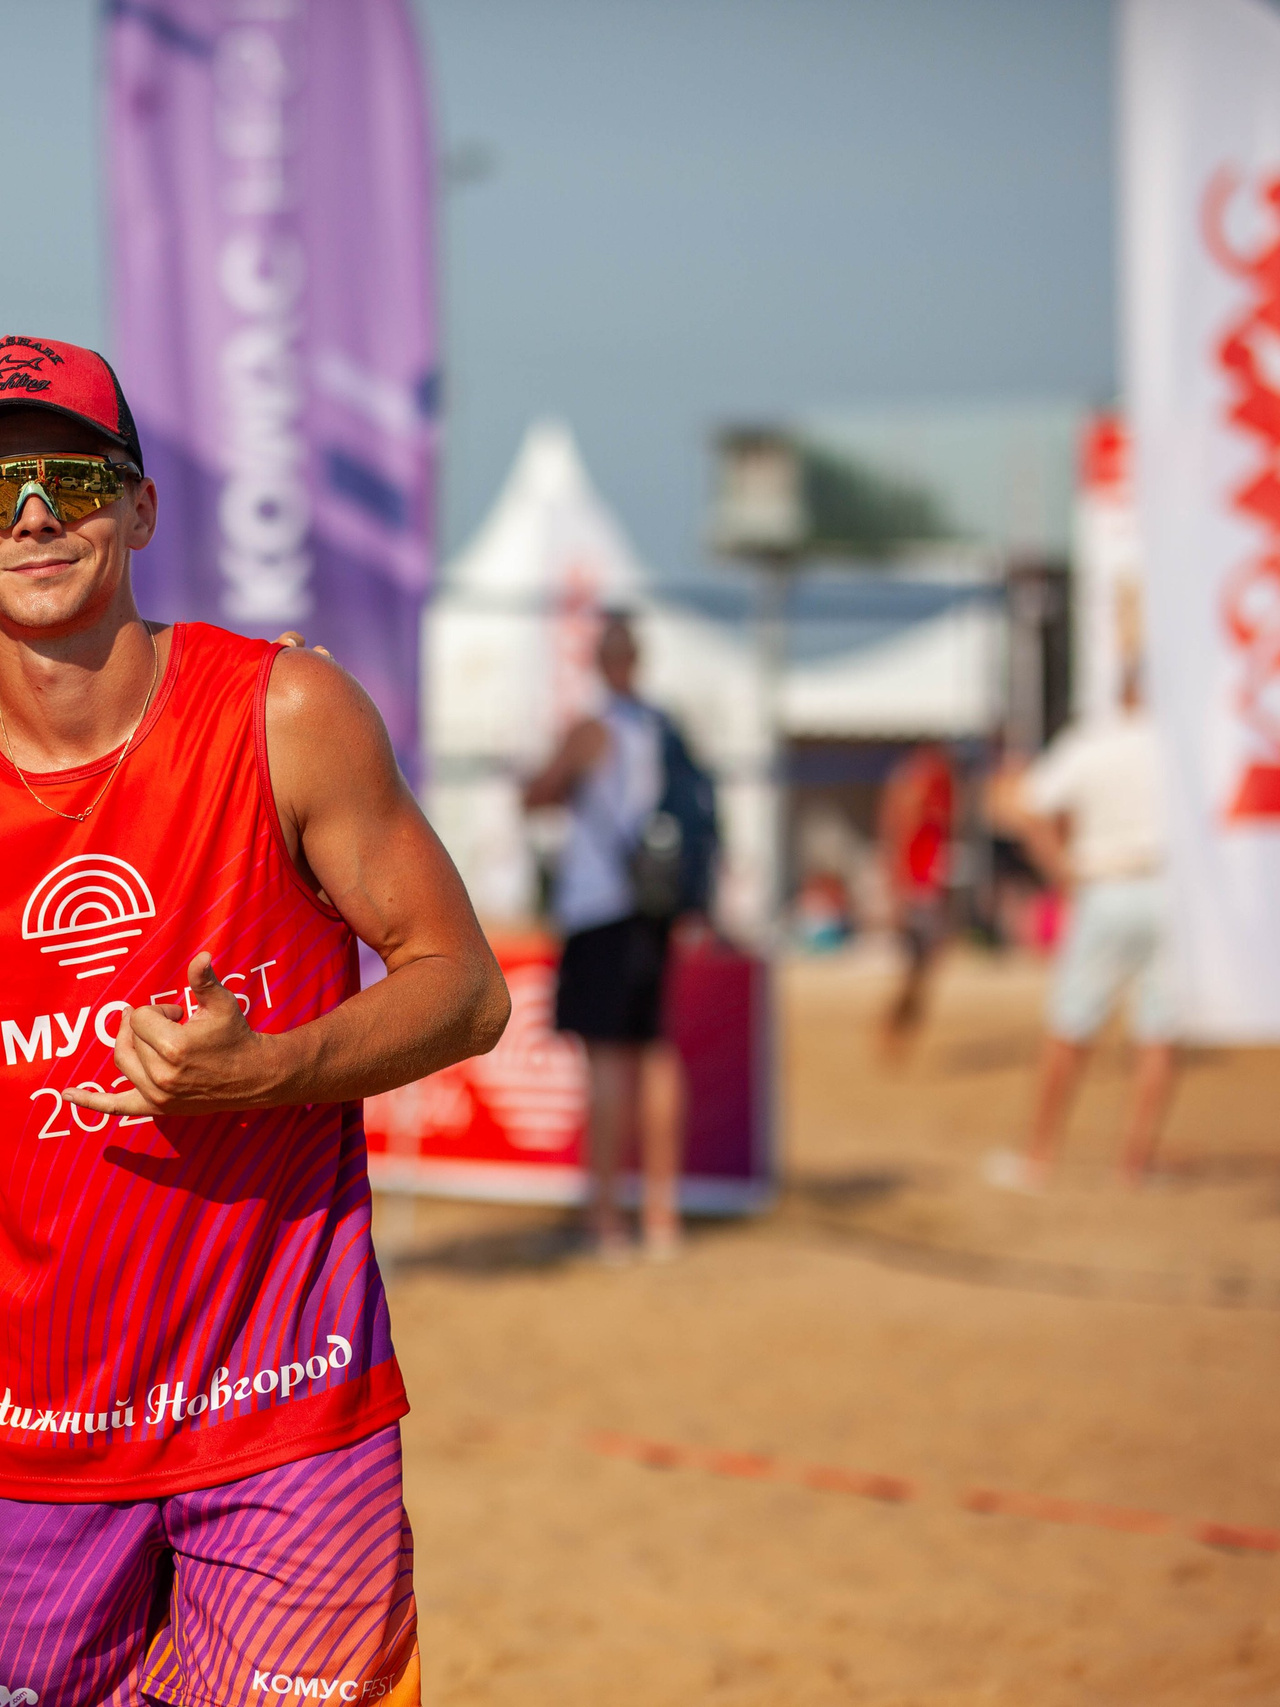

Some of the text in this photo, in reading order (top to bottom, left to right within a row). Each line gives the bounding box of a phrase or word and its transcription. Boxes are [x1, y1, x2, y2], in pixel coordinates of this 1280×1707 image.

[29, 1076, 154, 1140] 202
[145, 1334, 354, 1425] Новгород
[252, 1669, 396, 1702] КОМУС FEST
